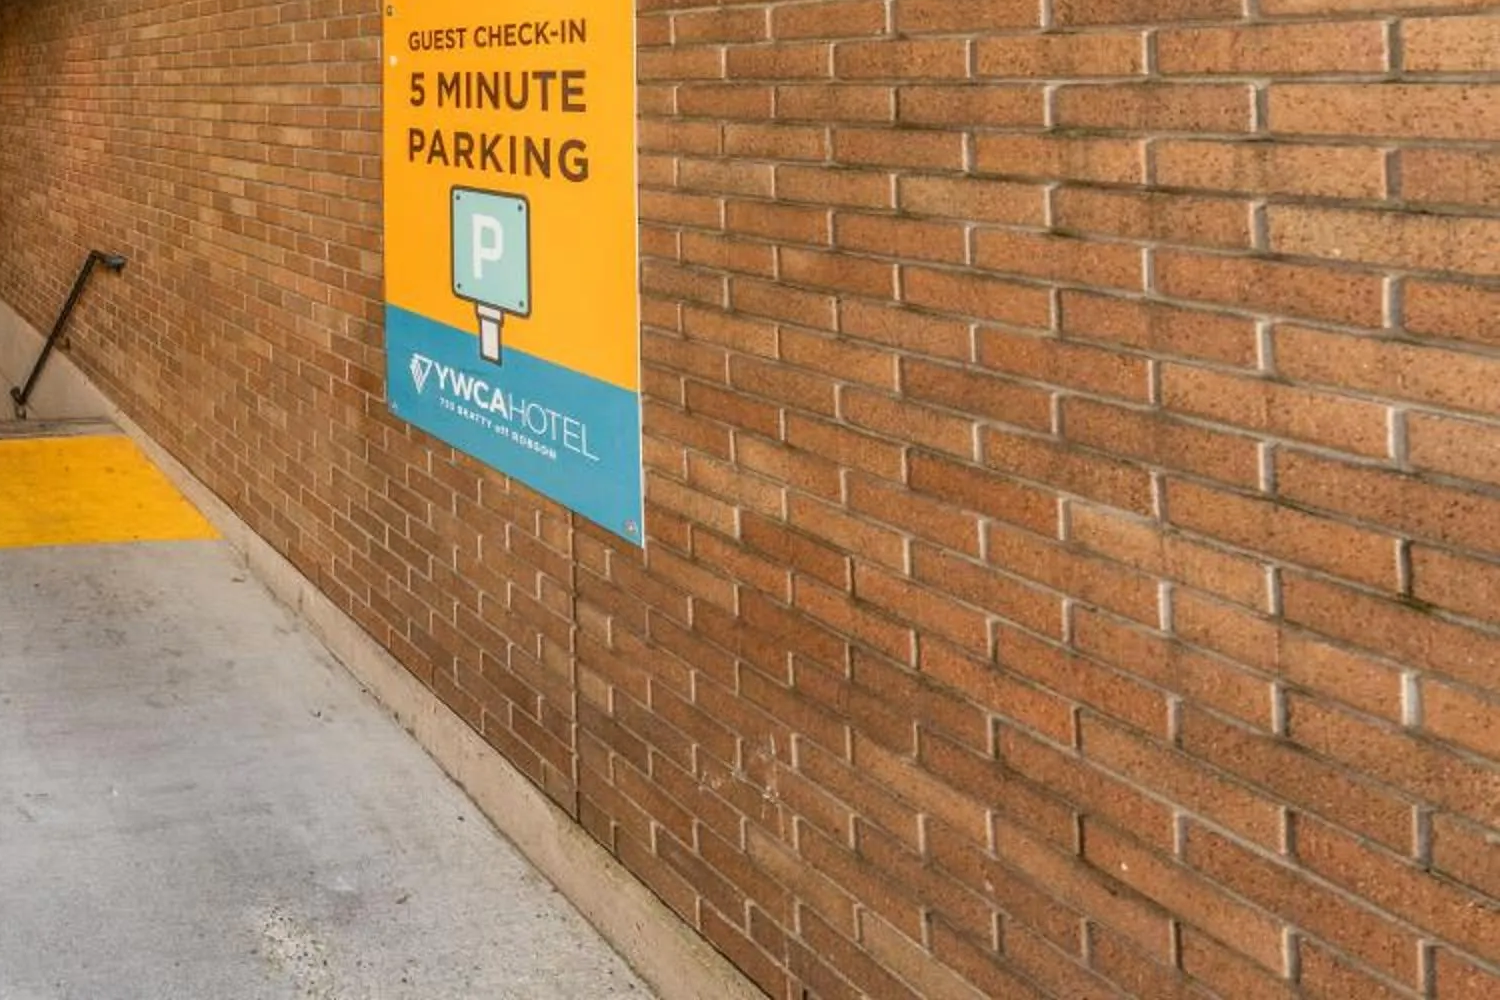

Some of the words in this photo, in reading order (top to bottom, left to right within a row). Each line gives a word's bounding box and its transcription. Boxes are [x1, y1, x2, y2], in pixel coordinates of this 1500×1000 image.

[408, 27, 467, 51] GUEST
[474, 17, 587, 49] CHECK-IN
[409, 71, 426, 108] 5
[436, 69, 587, 113] MINUTE
[408, 127, 590, 183] PARKING
[471, 213, 505, 281] P
